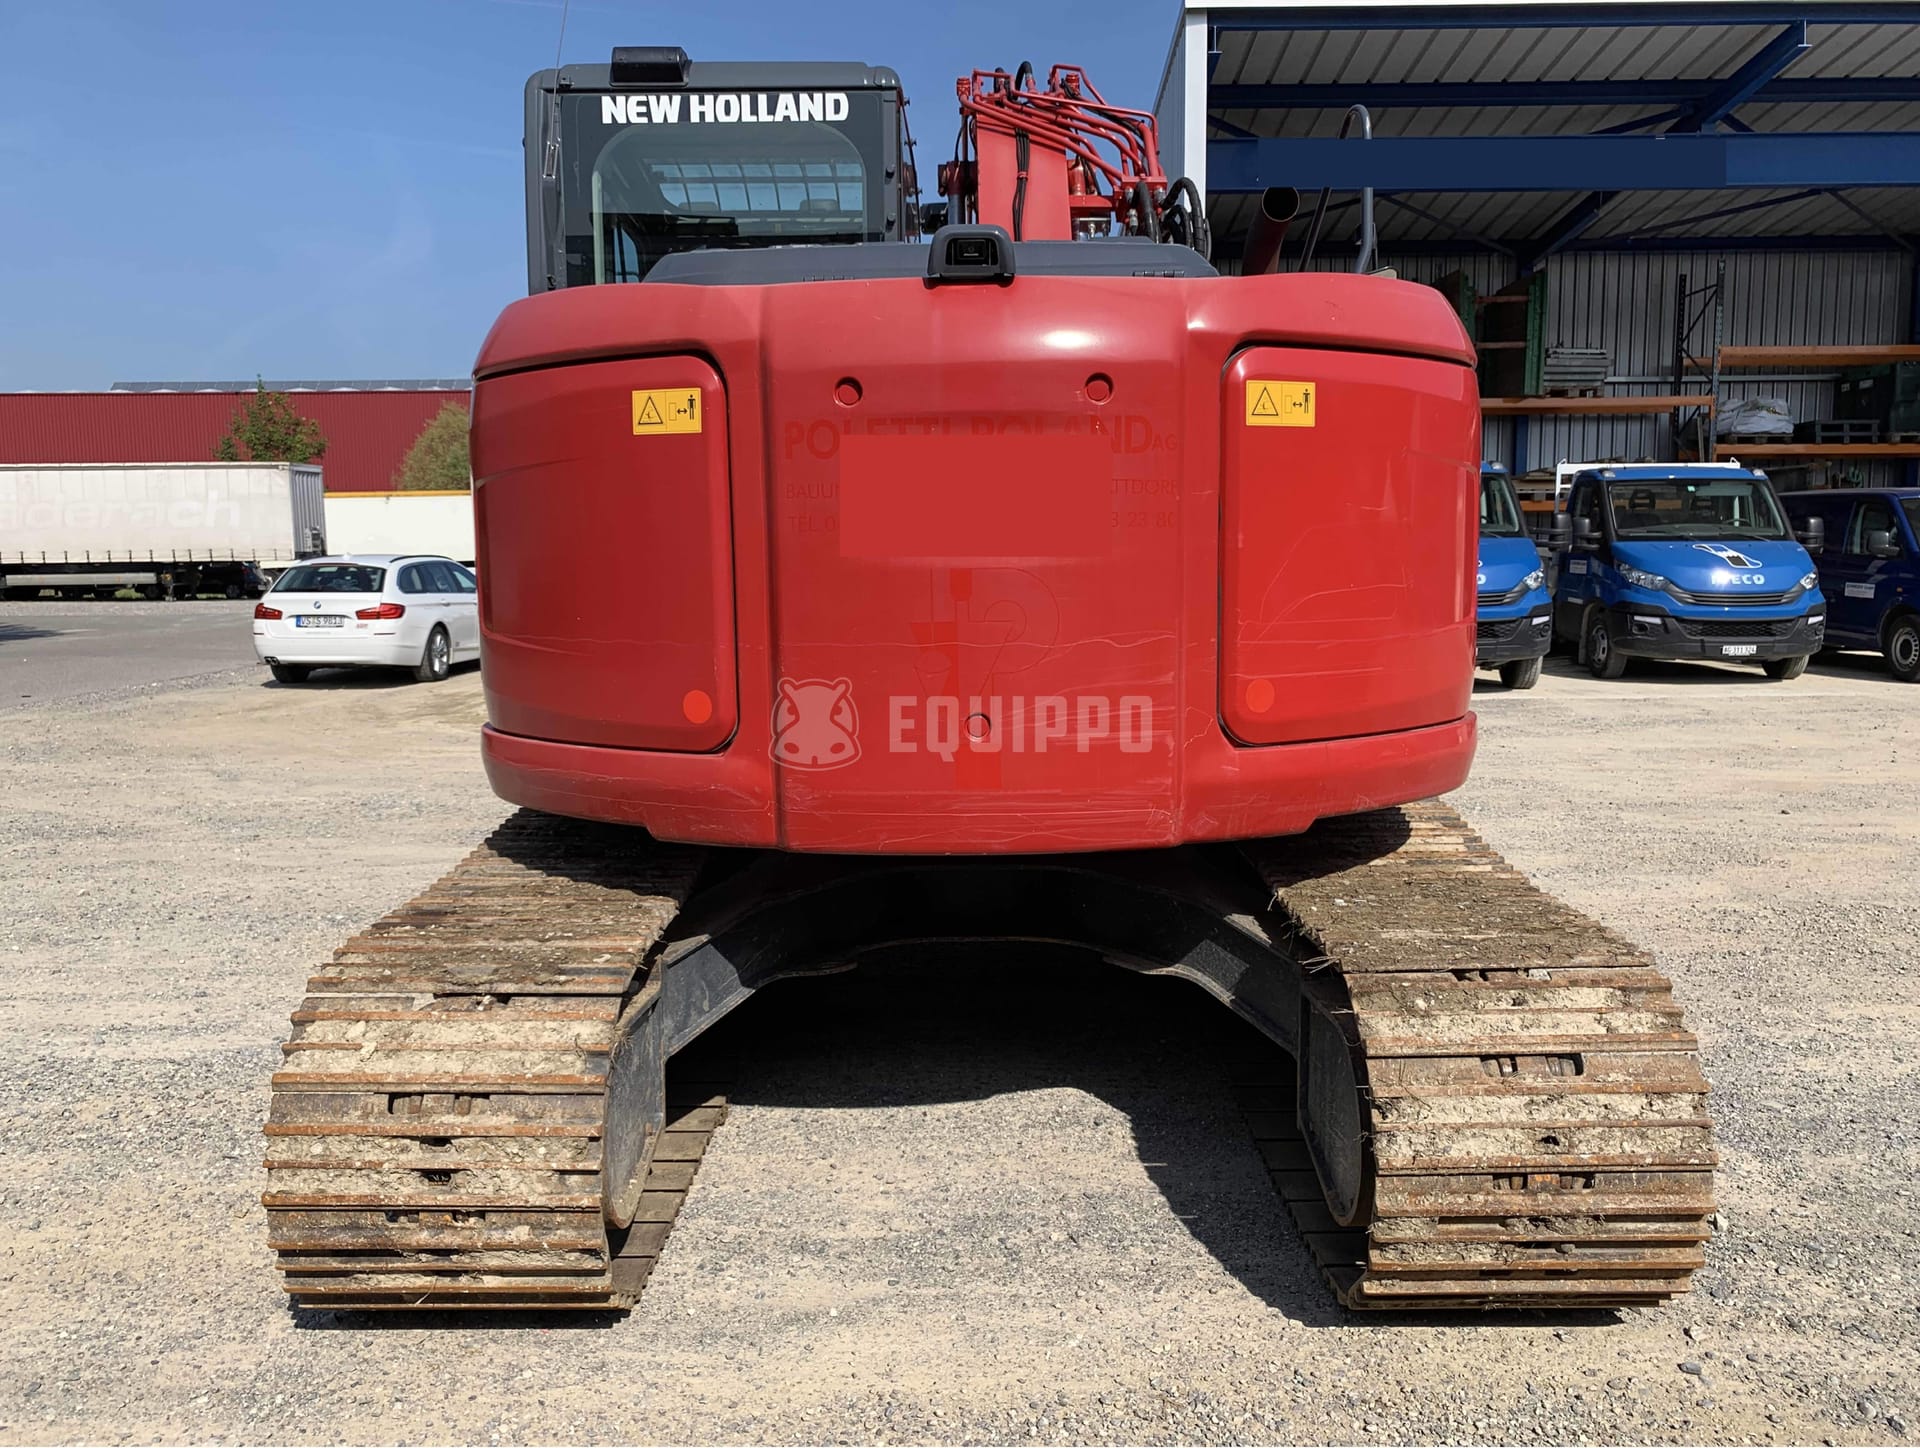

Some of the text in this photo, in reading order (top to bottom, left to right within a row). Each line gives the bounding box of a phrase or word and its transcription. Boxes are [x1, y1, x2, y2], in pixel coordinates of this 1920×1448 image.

[601, 92, 850, 124] NEW HOLLAND
[1152, 433, 1178, 452] AG
